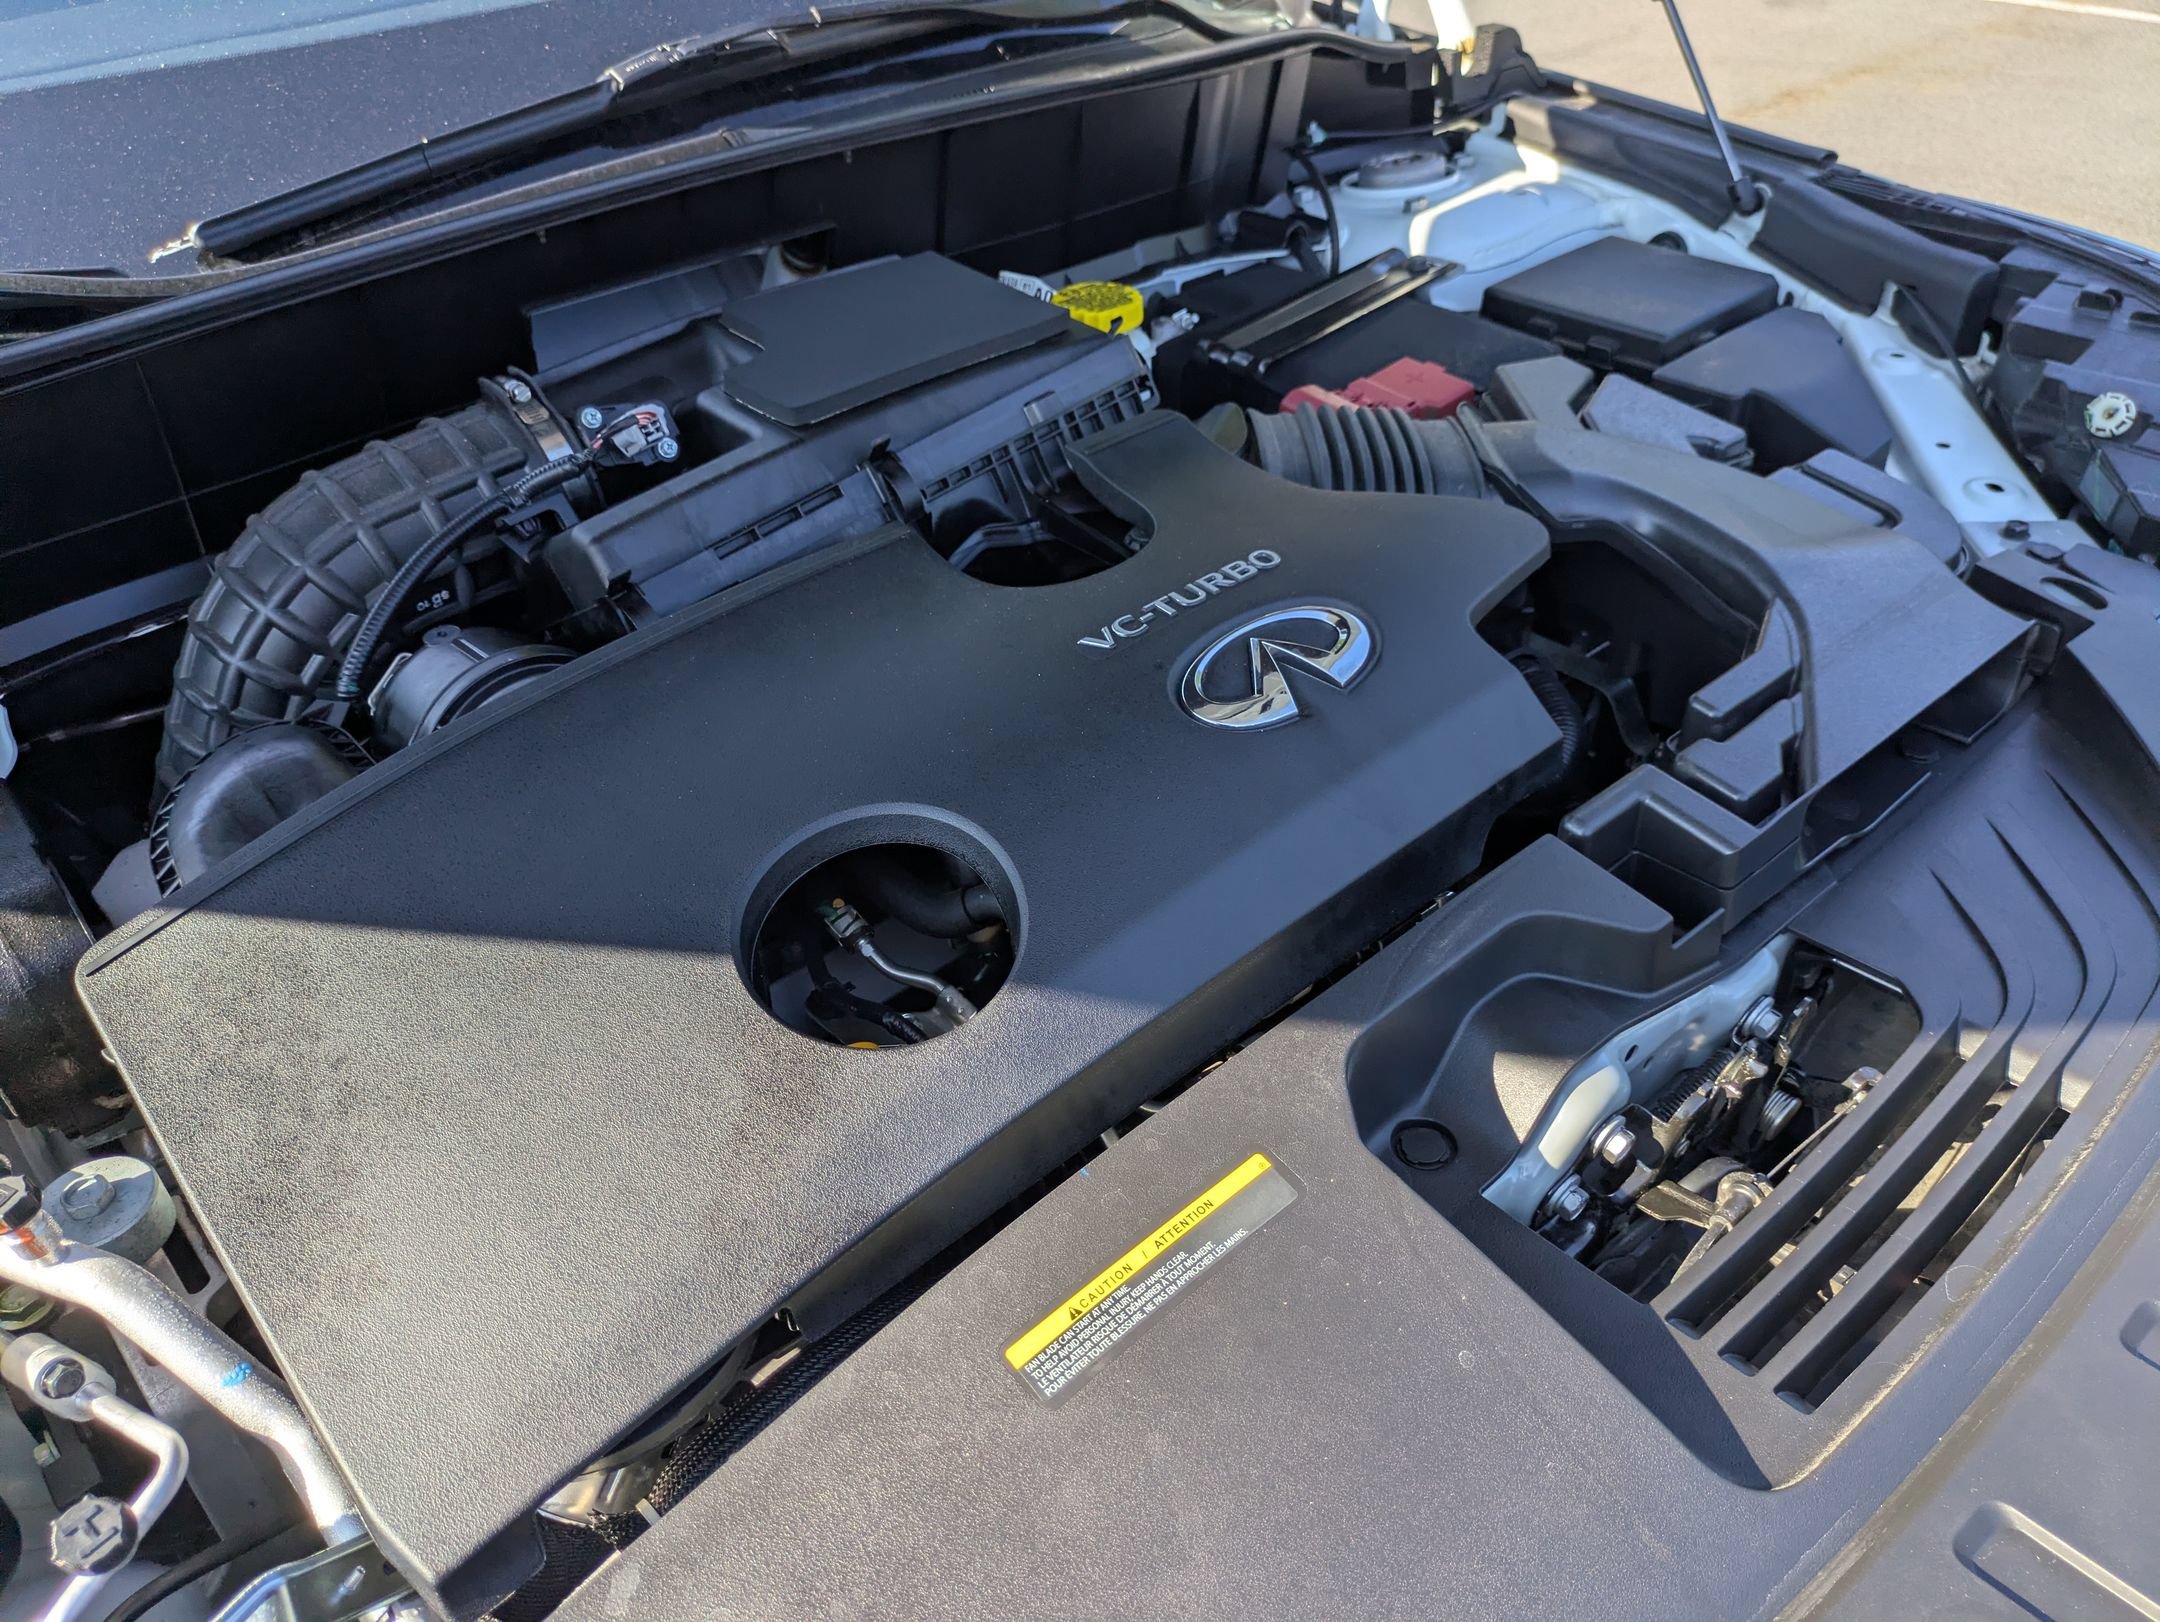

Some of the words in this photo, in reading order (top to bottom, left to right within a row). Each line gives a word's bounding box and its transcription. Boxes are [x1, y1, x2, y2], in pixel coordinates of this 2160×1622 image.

[1077, 550, 1281, 649] VC-TURBO
[1044, 1376, 1067, 1396] POUR
[1064, 1356, 1090, 1379] ÉVITER
[1087, 1338, 1113, 1360] TOUTE
[1110, 1311, 1146, 1342] BLESSURE,
[1143, 1301, 1156, 1313] NE
[1153, 1292, 1168, 1305] PAS
[1166, 1283, 1177, 1294] EN
[1176, 1254, 1215, 1287] APPROCHER
[1213, 1245, 1226, 1257] LES
[1224, 1228, 1248, 1248] MAINS.
[1079, 1263, 1132, 1309] CAUTION
[1153, 1199, 1214, 1250] ATTENTION
[1025, 1359, 1040, 1373] FAN
[1038, 1342, 1061, 1362] BLADE
[1058, 1330, 1075, 1344] CAN
[1072, 1315, 1093, 1333] START
[1091, 1307, 1102, 1318] AT
[1099, 1296, 1116, 1311] ANY
[1112, 1284, 1131, 1300] TIME.
[1032, 1368, 1044, 1380] TO
[1041, 1356, 1060, 1372] HELP
[1058, 1339, 1080, 1358] AVOID
[1077, 1313, 1112, 1342] PERSONAL
[1109, 1295, 1134, 1317] INJURY,
[1130, 1283, 1147, 1298] KEEP
[1145, 1266, 1169, 1287] HANDS
[1166, 1251, 1188, 1270] CLEAR.
[1037, 1377, 1049, 1388] LE
[1046, 1341, 1094, 1381] VENTILATEUR
[1092, 1320, 1119, 1343] RISQUE
[1116, 1311, 1128, 1323] DE
[1125, 1283, 1163, 1315] DÉMARRER
[1160, 1277, 1169, 1286] À
[1166, 1265, 1186, 1282] TOUT
[1184, 1241, 1216, 1268] MOMENT.
